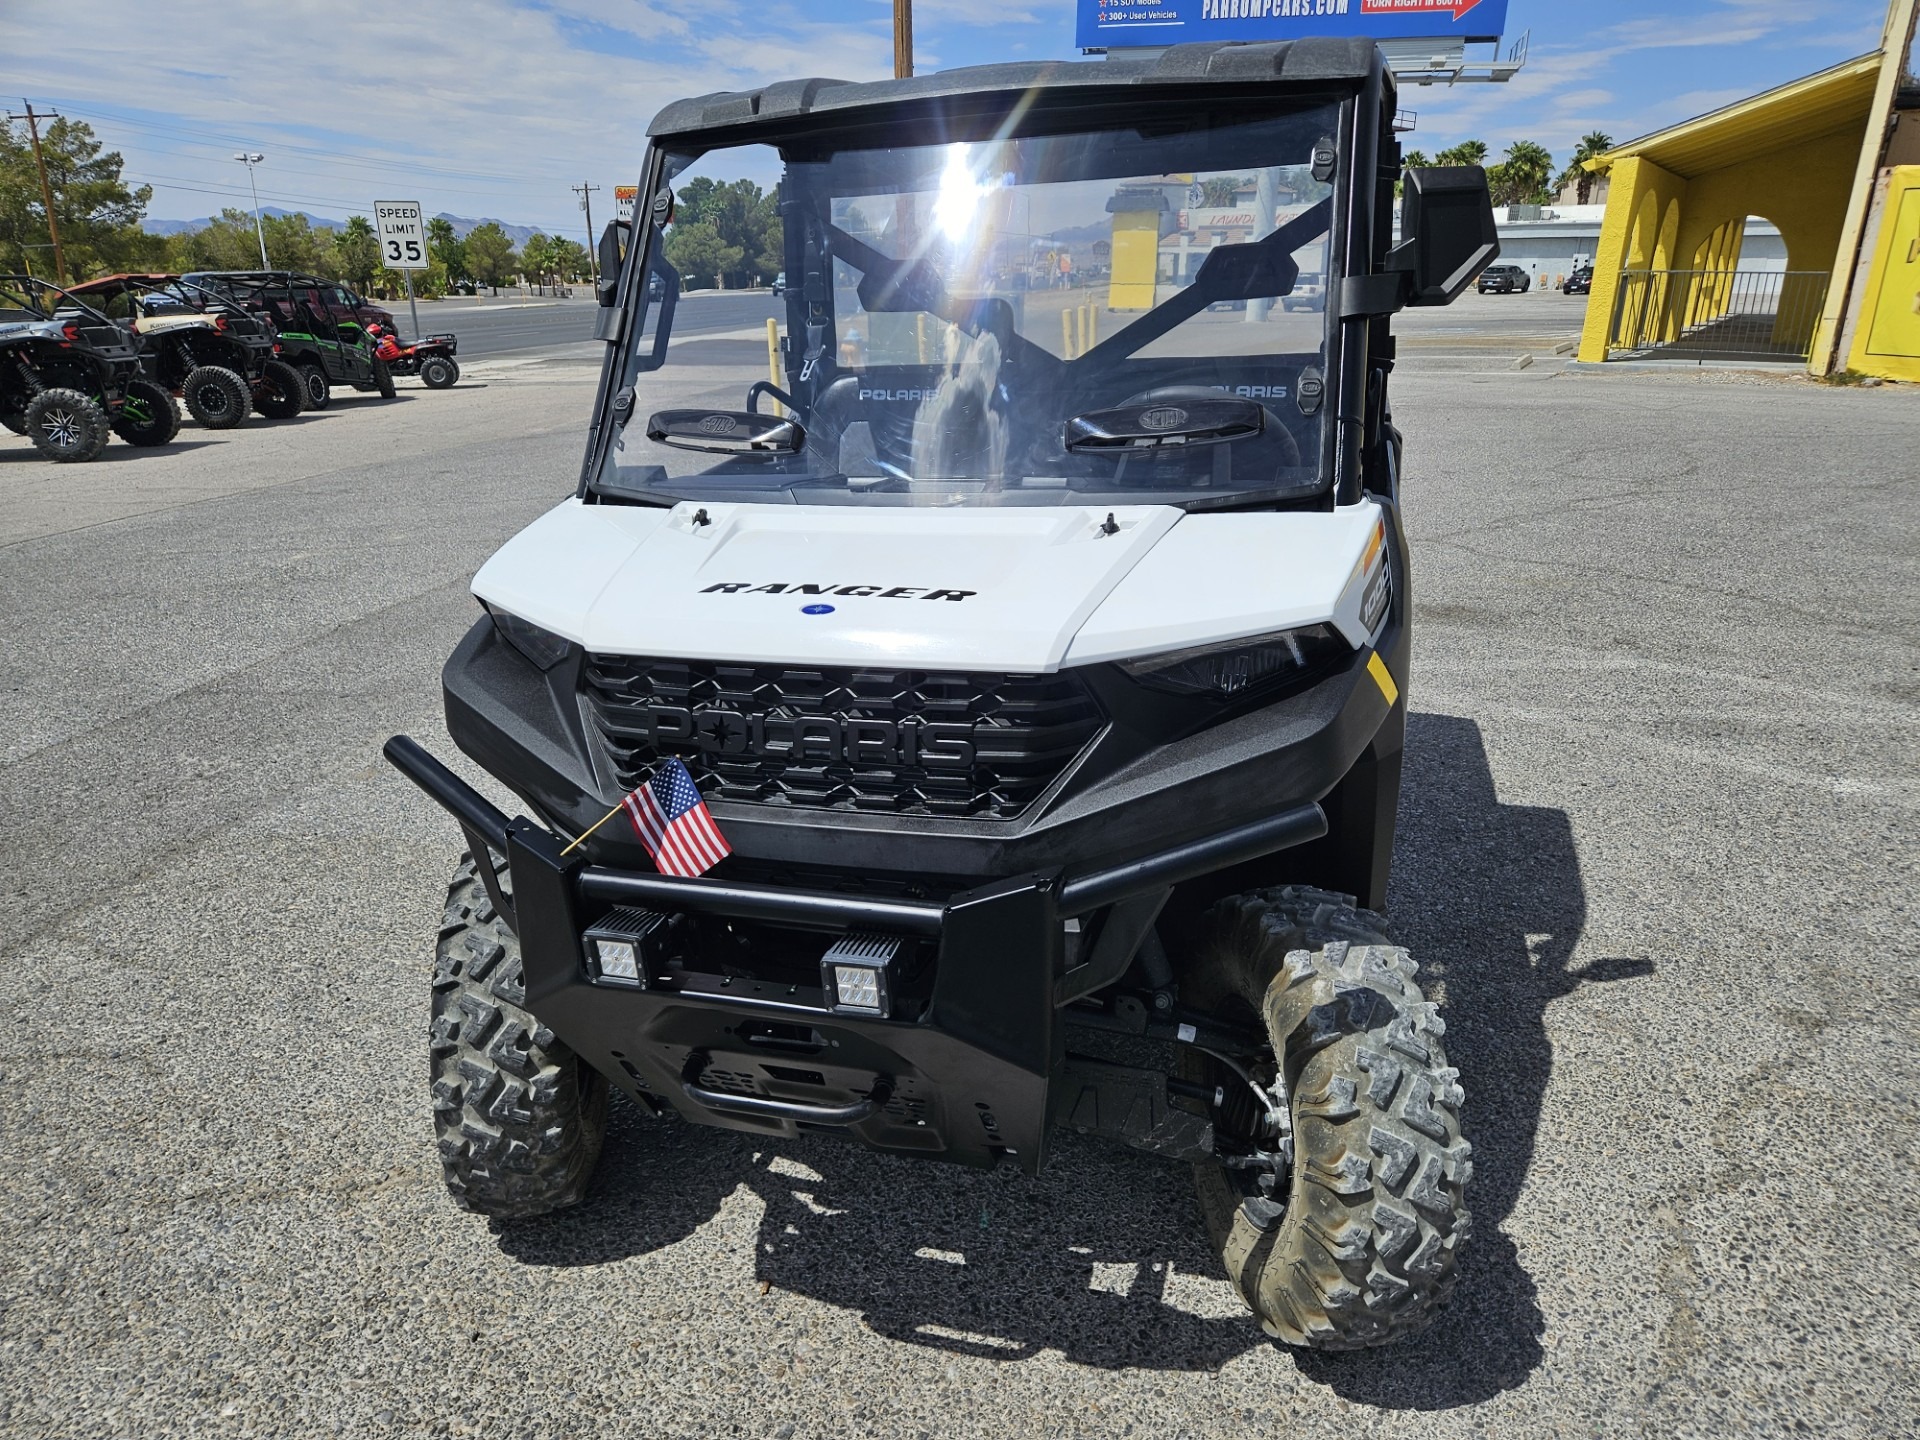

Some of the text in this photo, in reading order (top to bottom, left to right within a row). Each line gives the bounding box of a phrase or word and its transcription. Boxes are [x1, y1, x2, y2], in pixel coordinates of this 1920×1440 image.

[1108, 11, 1177, 20] 300+ Used Vehicles
[380, 208, 417, 218] SPEED
[385, 224, 415, 234] LIMIT
[387, 240, 421, 261] 35
[859, 389, 938, 400] POLARIS
[698, 583, 977, 601] RANGER
[647, 704, 977, 767] POLARIS
